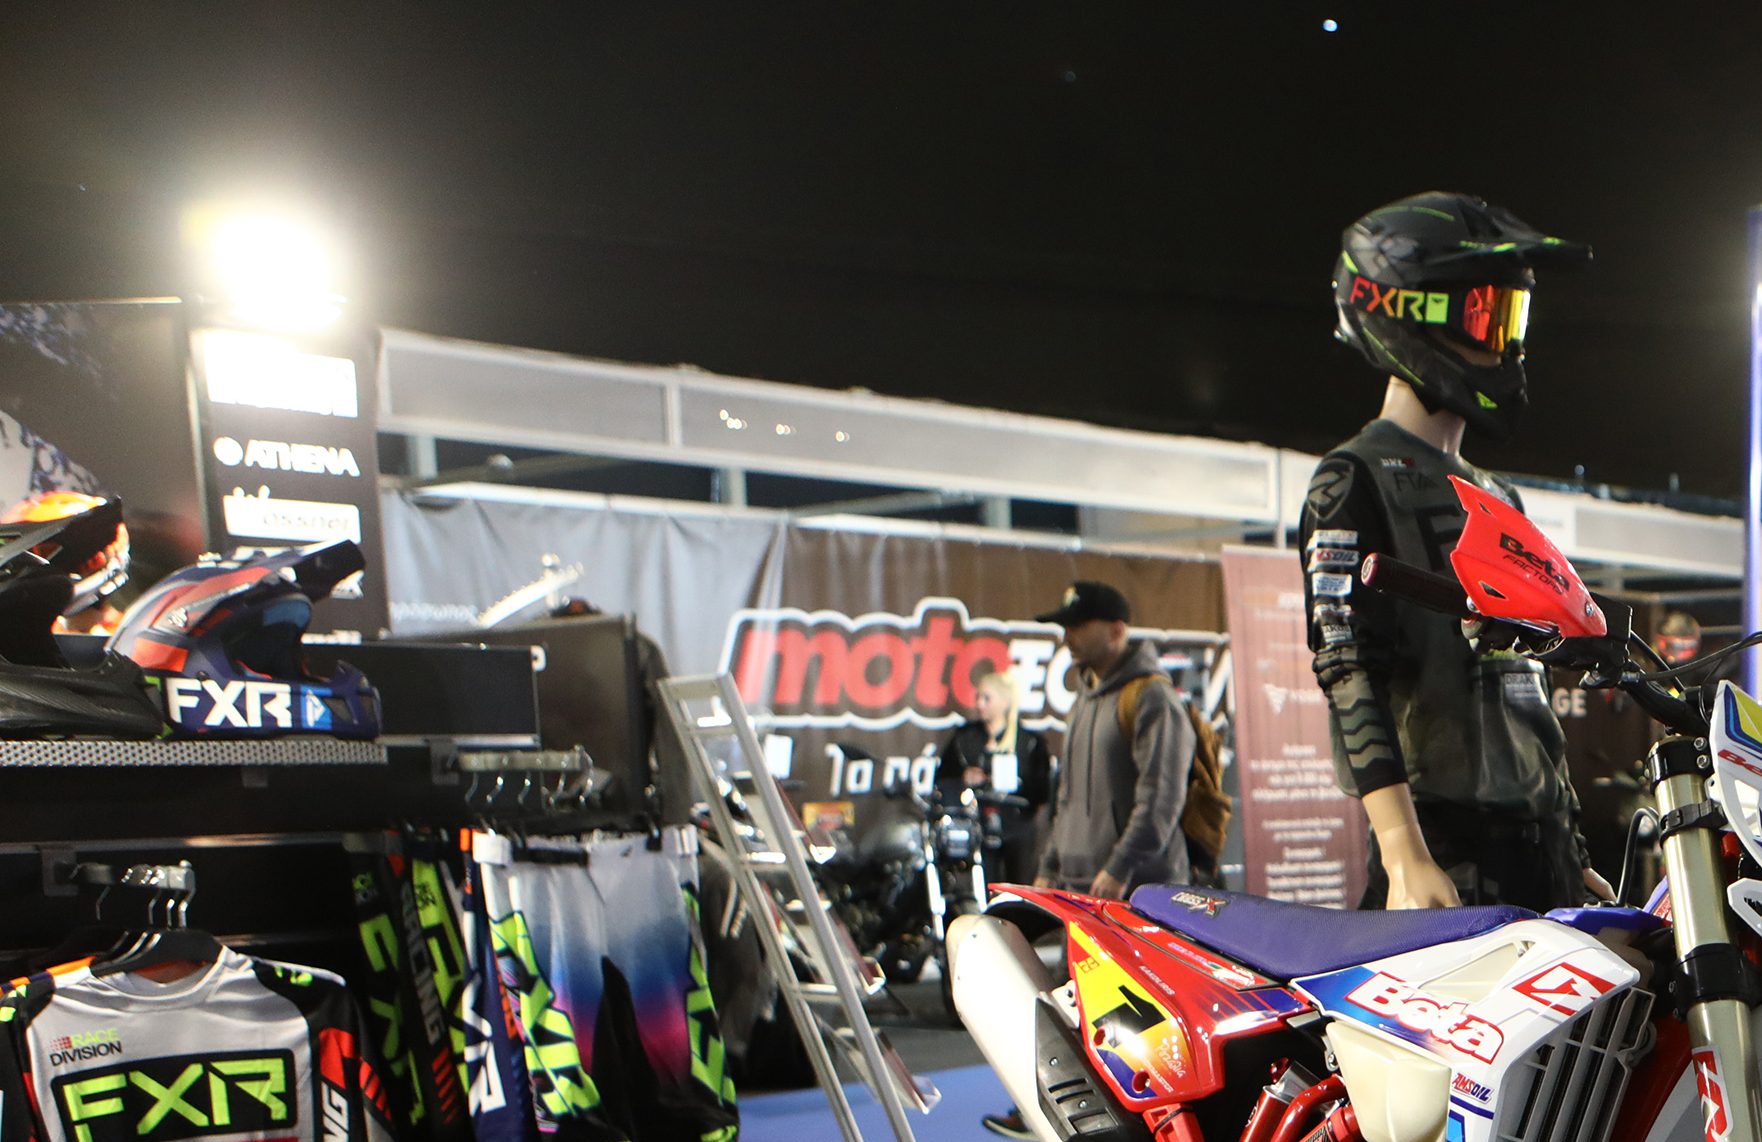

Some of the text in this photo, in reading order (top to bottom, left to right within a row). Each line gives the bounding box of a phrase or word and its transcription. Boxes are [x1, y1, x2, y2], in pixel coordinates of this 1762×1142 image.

[1350, 276, 1424, 322] FXR
[244, 439, 360, 477] ATHENA
[1499, 532, 1570, 591] Beta
[1503, 554, 1564, 595] FACTORY
[166, 677, 292, 728] FXR
[70, 1027, 119, 1048] RACE
[1344, 971, 1504, 1065] Beta
[50, 1040, 122, 1068] DIVISION
[1452, 1072, 1493, 1103] AMSOIL
